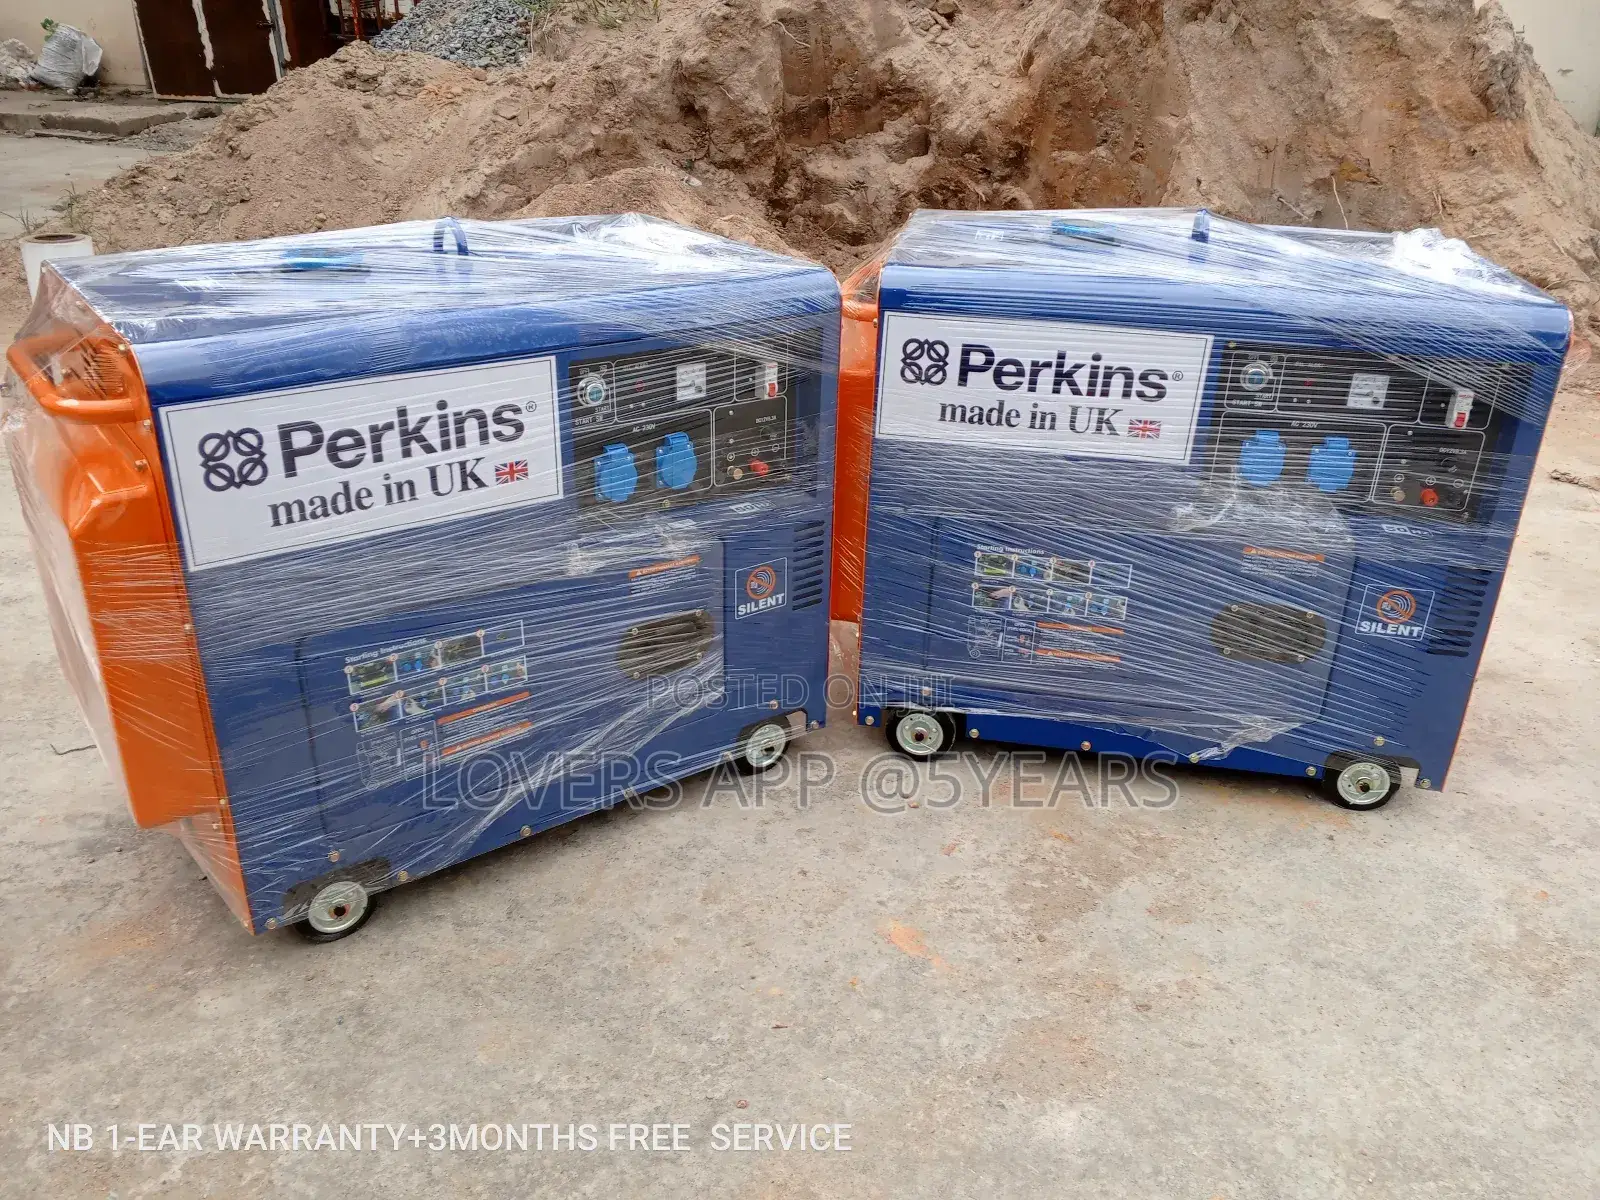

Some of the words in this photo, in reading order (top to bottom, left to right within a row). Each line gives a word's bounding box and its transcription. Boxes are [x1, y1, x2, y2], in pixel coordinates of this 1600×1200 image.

[957, 343, 1169, 402] Perkins
[938, 400, 1021, 427] made
[1028, 402, 1057, 430] in
[1069, 405, 1123, 436] UK
[278, 400, 525, 478] Perkins
[268, 481, 374, 527] made
[382, 473, 420, 507] in
[427, 457, 489, 497] UK
[977, 543, 1004, 552] Starting
[1005, 545, 1045, 555] Instructions
[738, 592, 785, 616] SILENT
[1359, 620, 1423, 638] SILENT
[380, 637, 428, 654] Instructions
